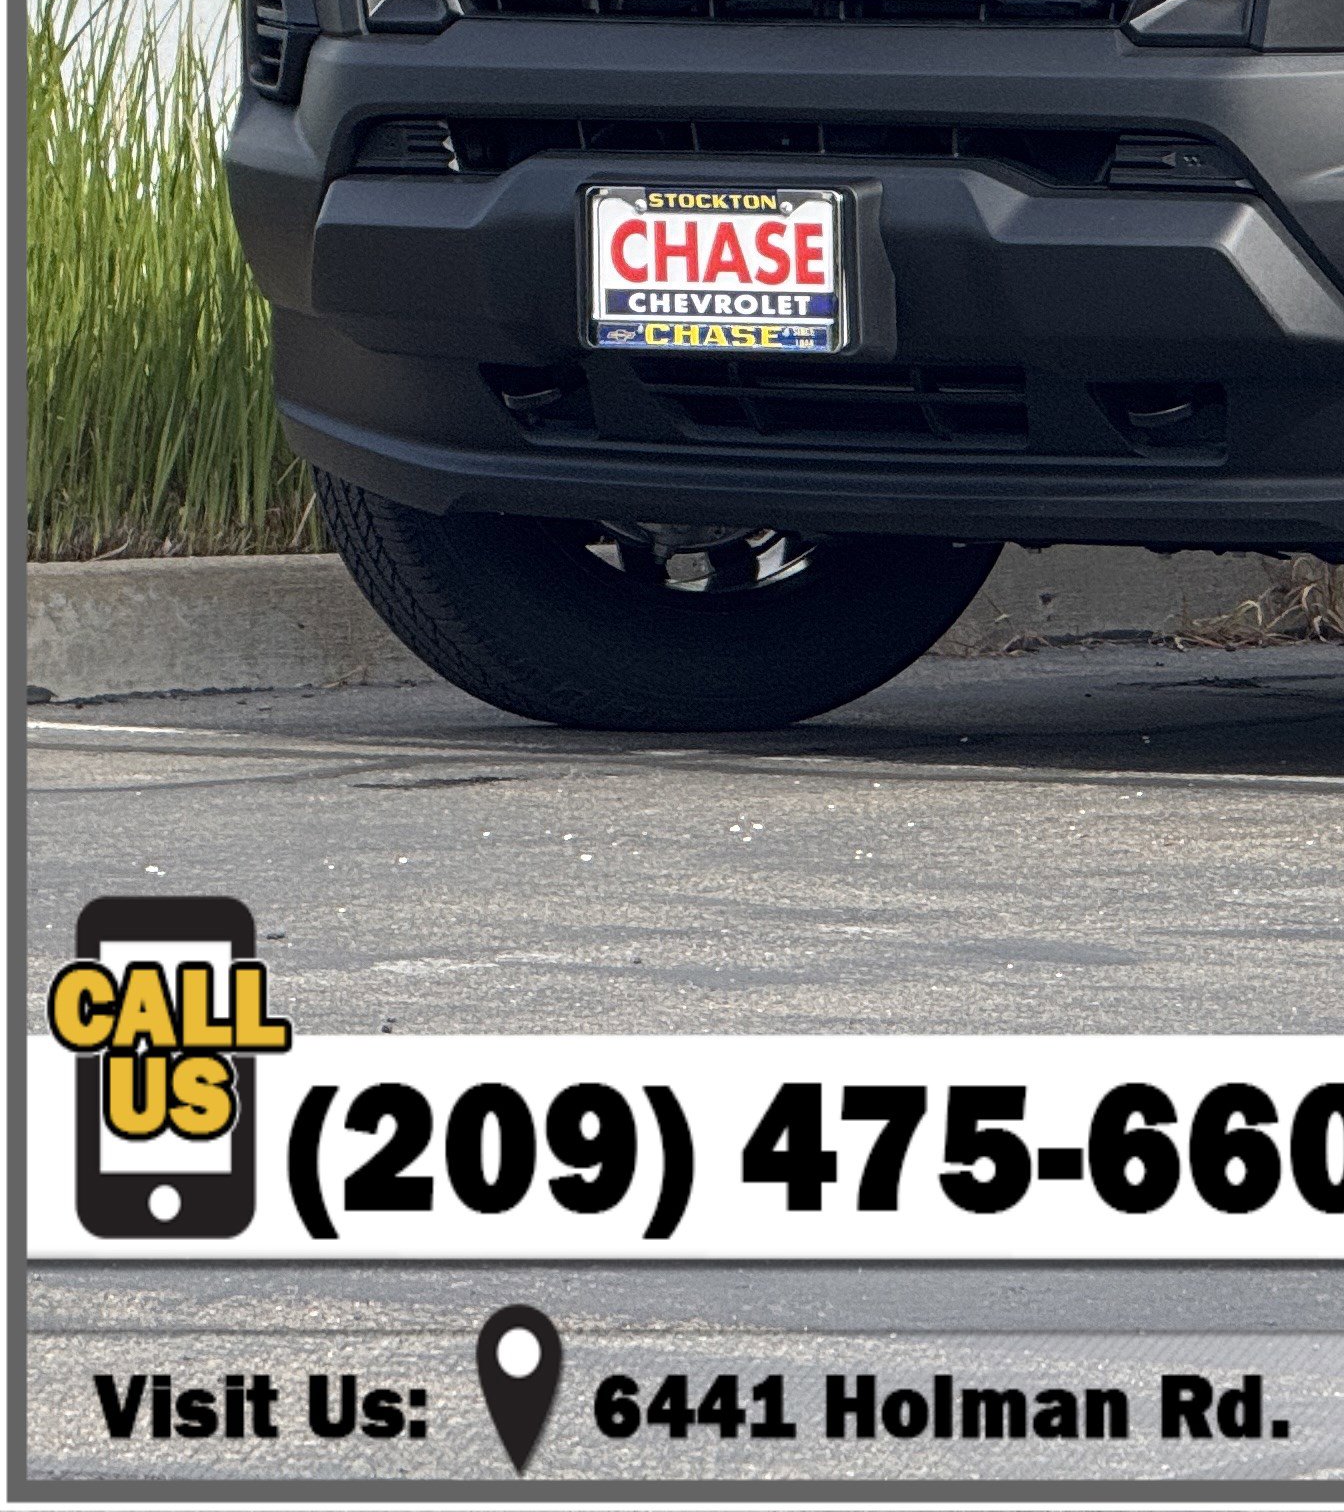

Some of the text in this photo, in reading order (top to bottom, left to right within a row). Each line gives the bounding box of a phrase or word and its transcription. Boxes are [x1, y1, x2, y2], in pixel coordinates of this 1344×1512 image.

[648, 192, 777, 210] STOCKTON
[610, 218, 825, 285] CHASE
[628, 292, 811, 316] CHEVROLET
[644, 323, 783, 348] CHASE
